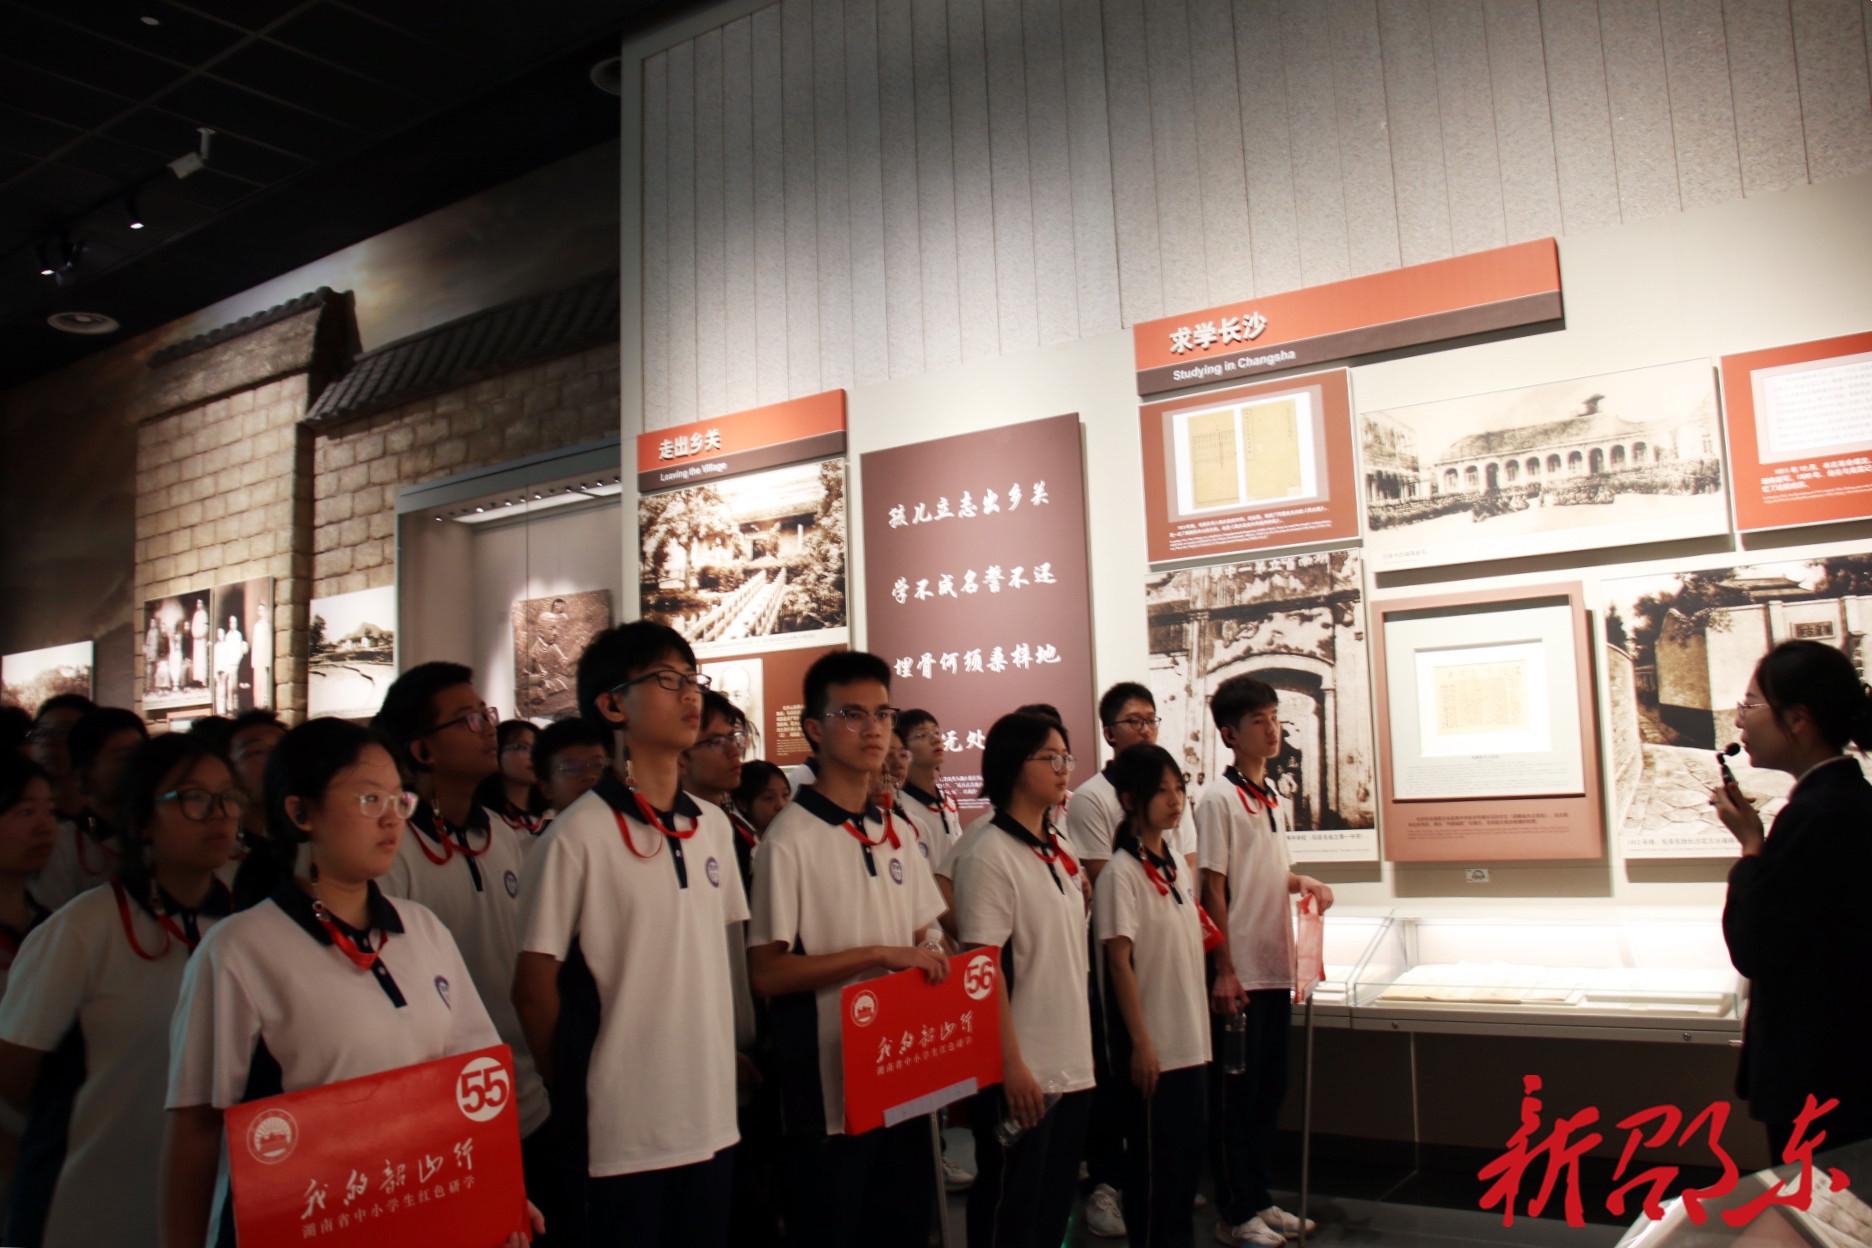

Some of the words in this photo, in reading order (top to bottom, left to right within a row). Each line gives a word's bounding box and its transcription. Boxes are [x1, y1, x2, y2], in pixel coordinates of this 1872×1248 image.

[1168, 311, 1269, 355] 求学长沙
[1172, 363, 1223, 381] Studying
[1224, 360, 1236, 372] in
[1237, 349, 1297, 369] Changsha
[658, 428, 721, 460] 走出乡关
[660, 469, 690, 482] Leaving
[688, 466, 702, 477] the
[701, 462, 728, 474] Village
[888, 480, 1050, 529] 孩儿立志出乡关
[891, 562, 1057, 604] 学不成名誓不还
[893, 643, 1062, 680] 埋骨何须桑梓地
[966, 960, 995, 994] 56
[460, 1064, 511, 1114] 55
[302, 1175, 475, 1239] 湖南省中小学生红色研学
